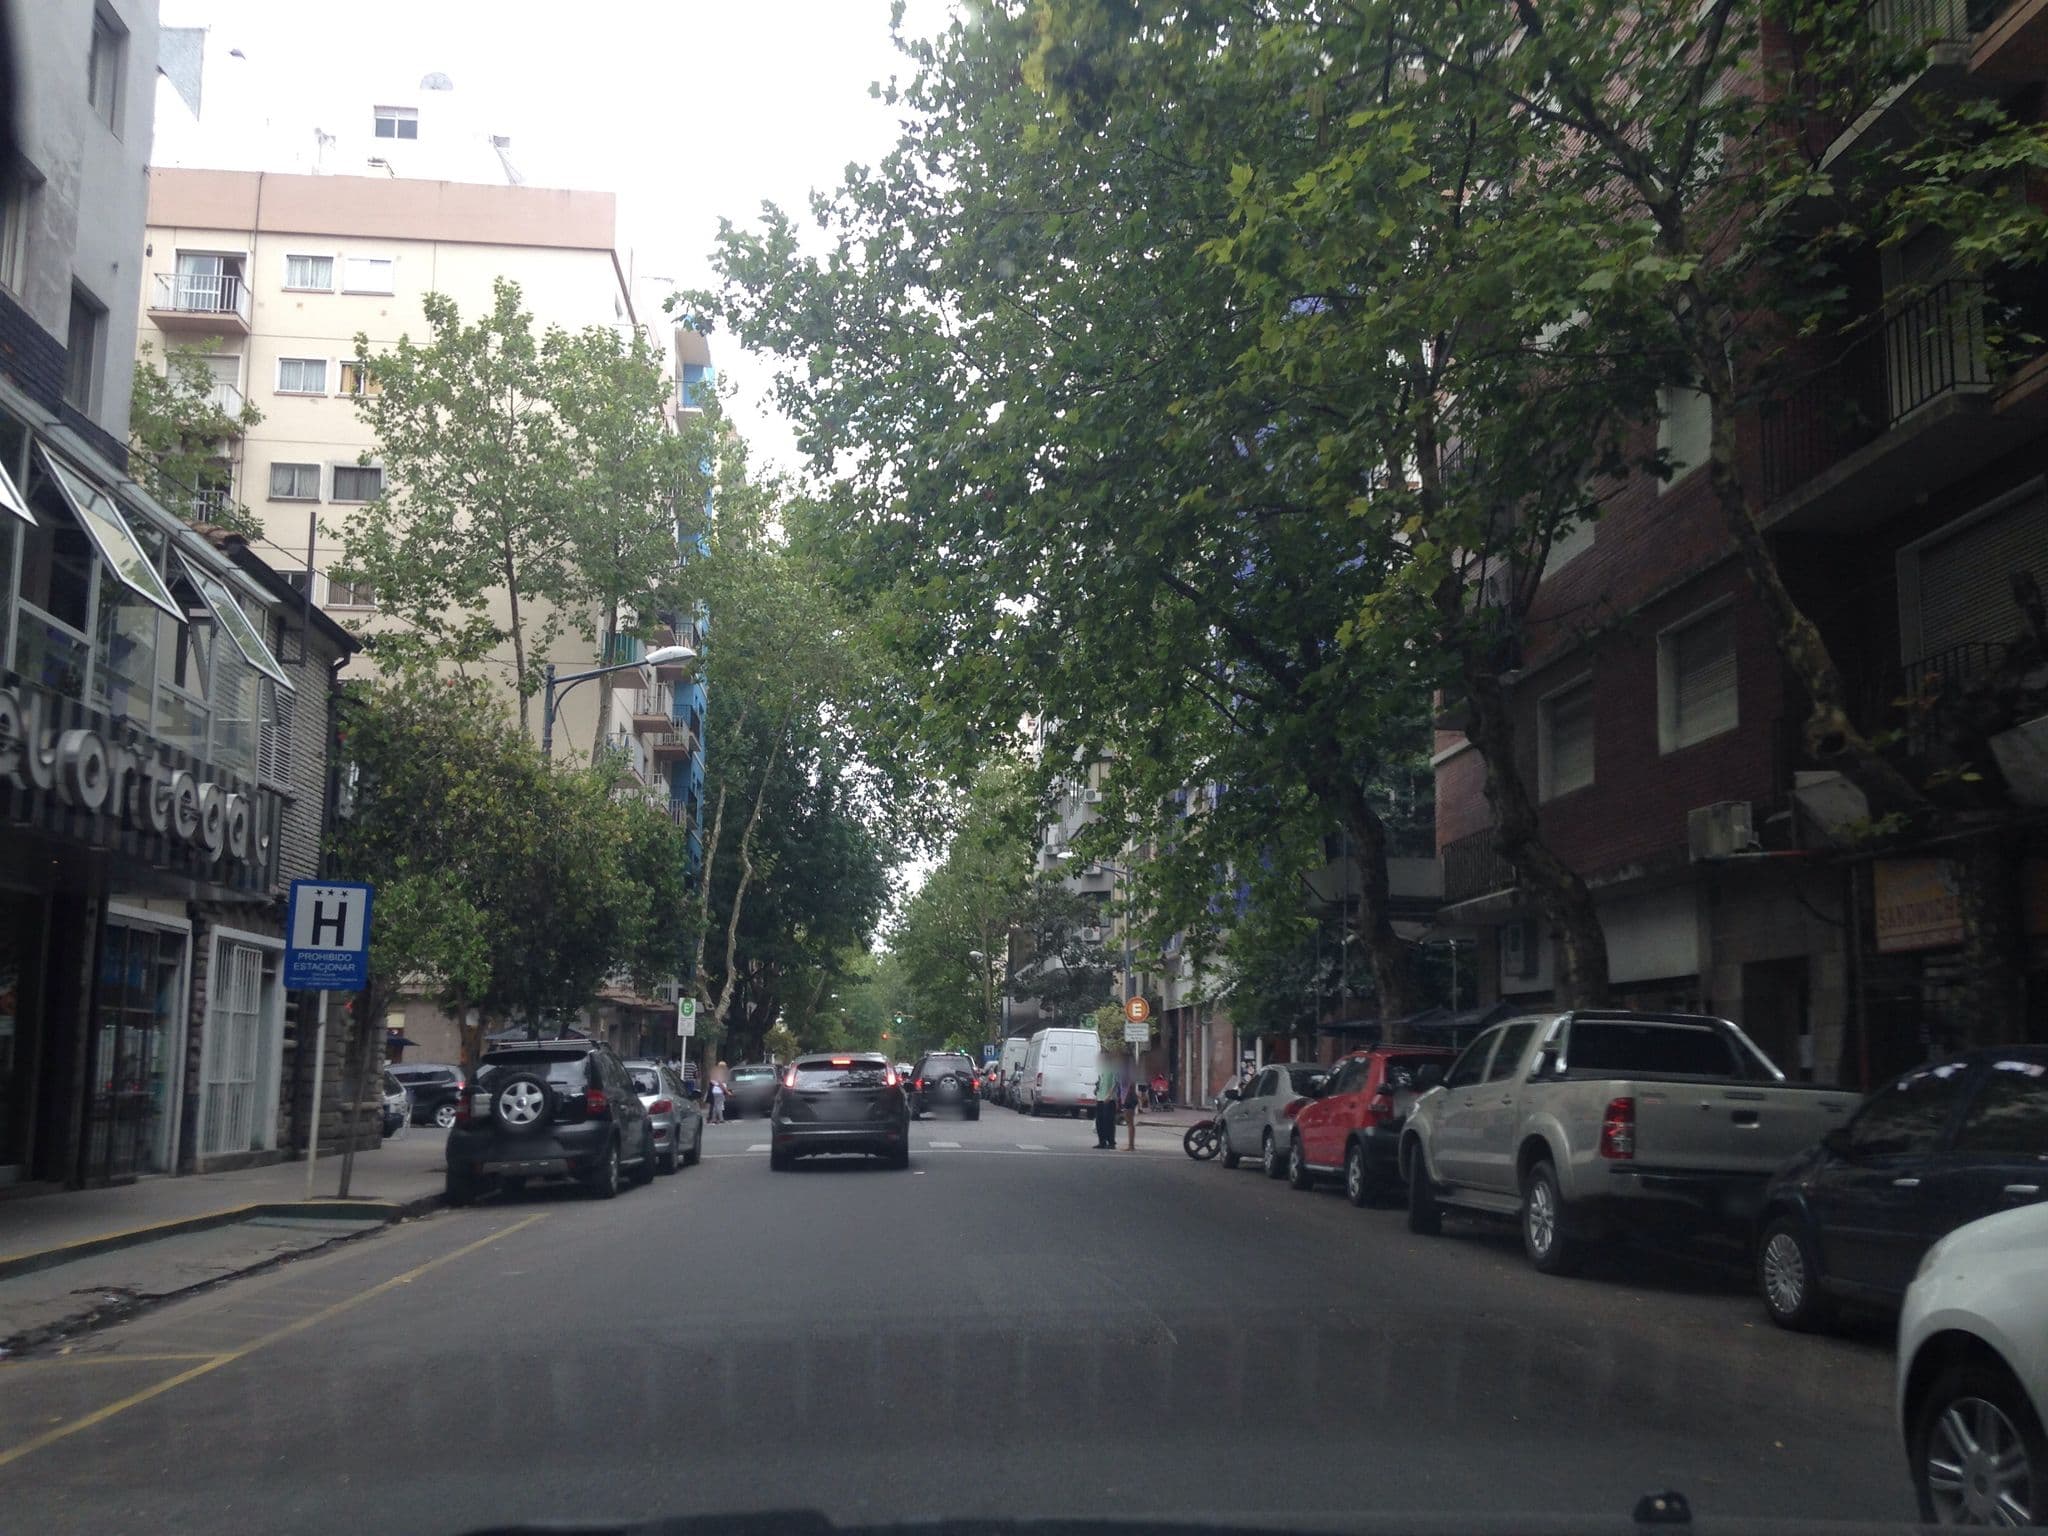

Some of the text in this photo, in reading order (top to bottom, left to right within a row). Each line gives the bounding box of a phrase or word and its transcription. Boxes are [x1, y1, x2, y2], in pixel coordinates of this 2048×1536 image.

[312, 900, 347, 946] H
[298, 952, 353, 962] PROHIBIDO
[294, 962, 356, 972] ESTACIONAR
[1132, 1003, 1142, 1017] E
